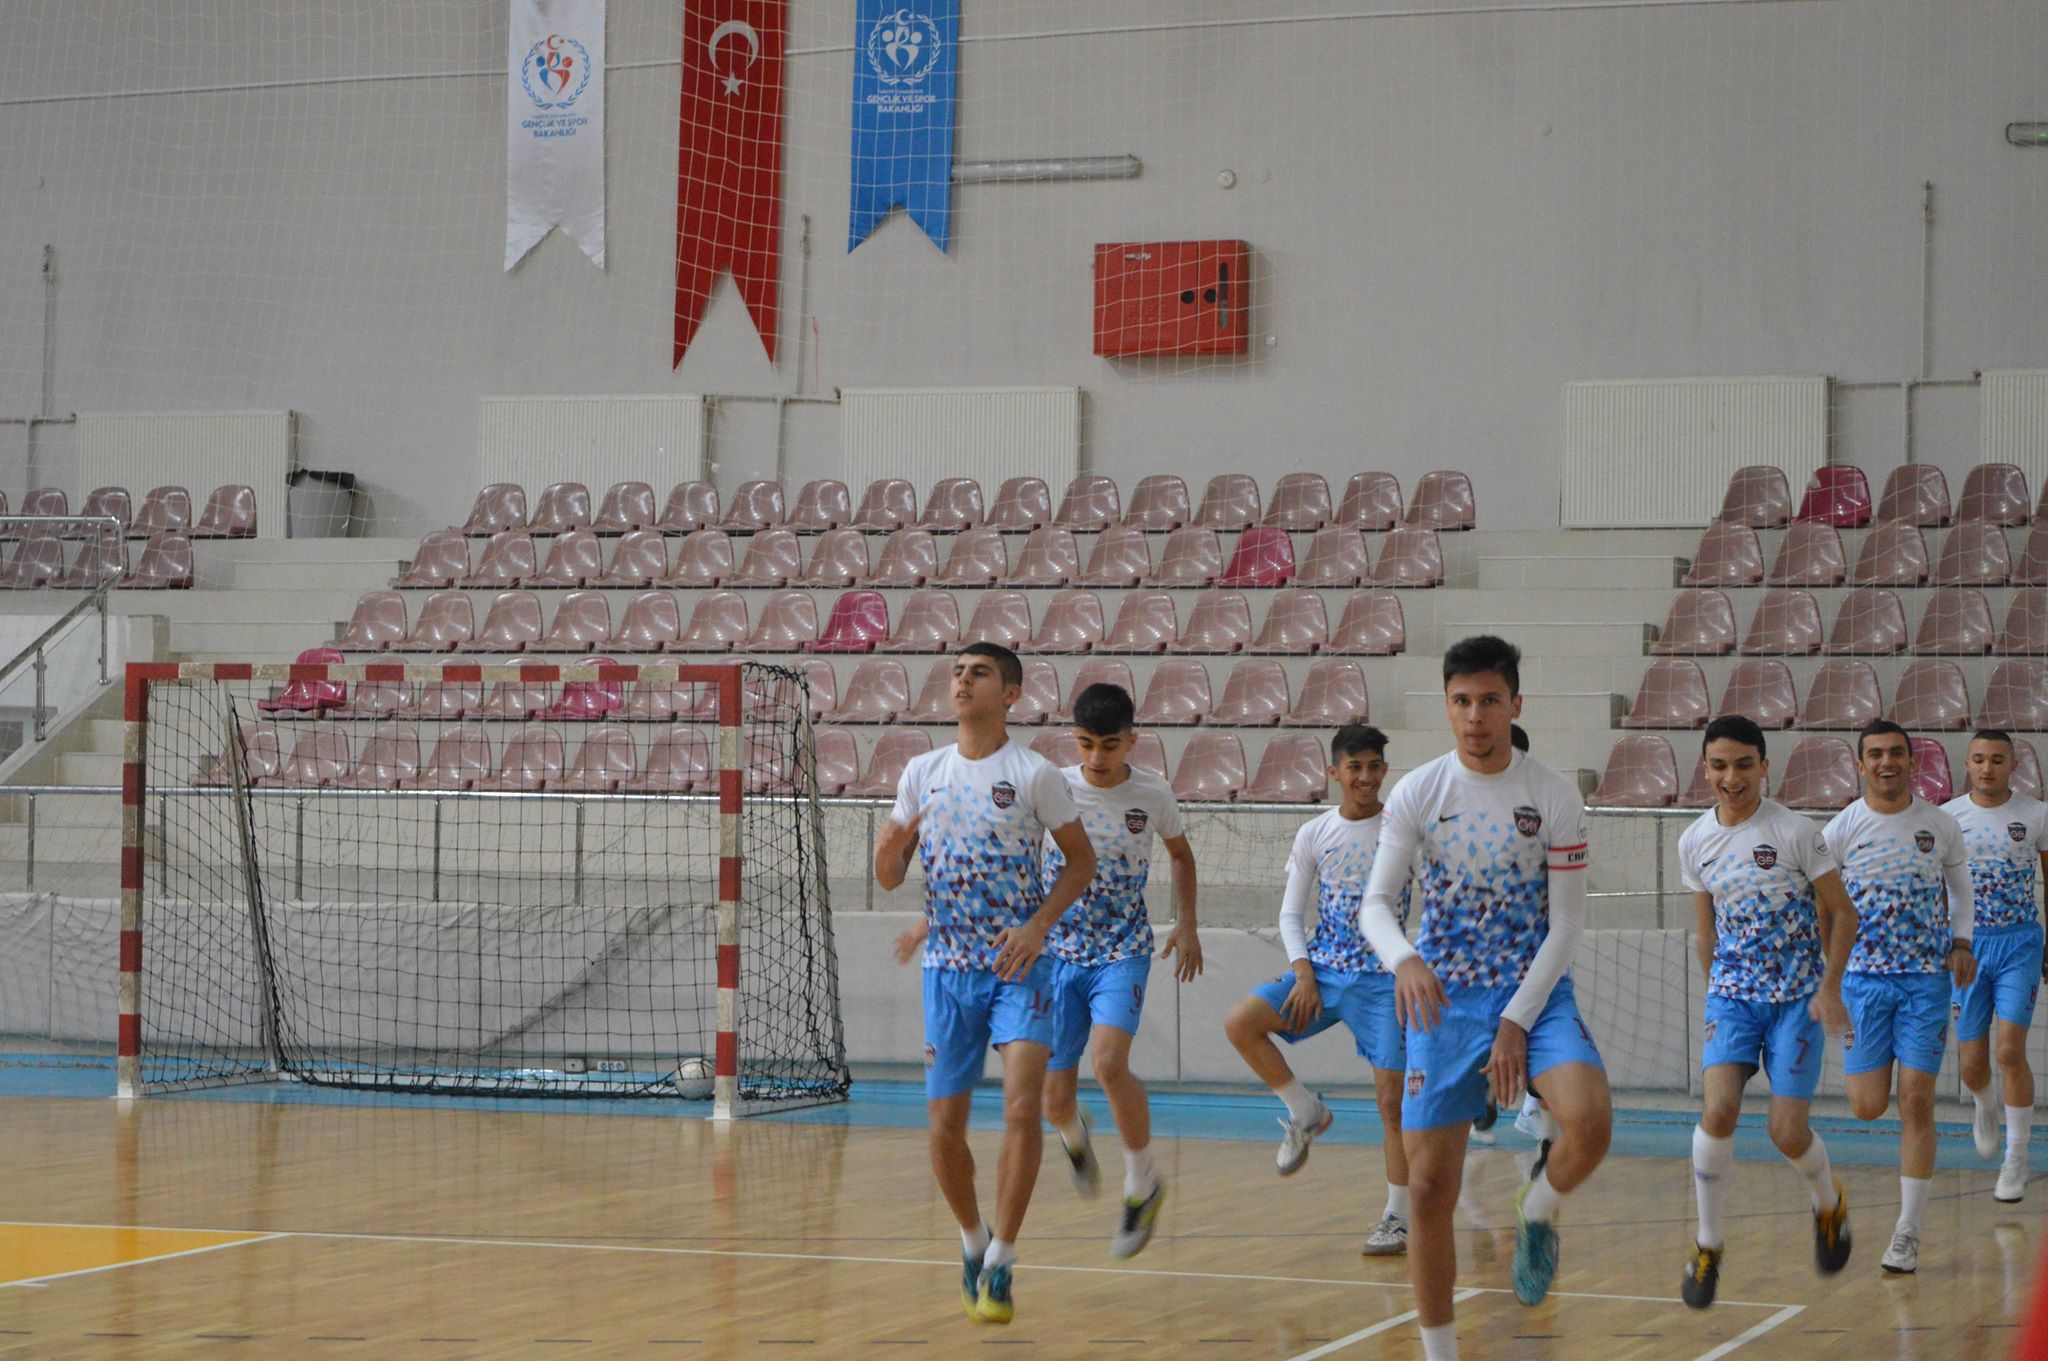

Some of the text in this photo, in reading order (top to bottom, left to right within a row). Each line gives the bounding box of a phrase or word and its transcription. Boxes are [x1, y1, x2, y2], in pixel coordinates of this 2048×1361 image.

[902, 94, 914, 104] VE
[914, 94, 937, 104] SPOR
[1795, 1036, 1810, 1065] 7
